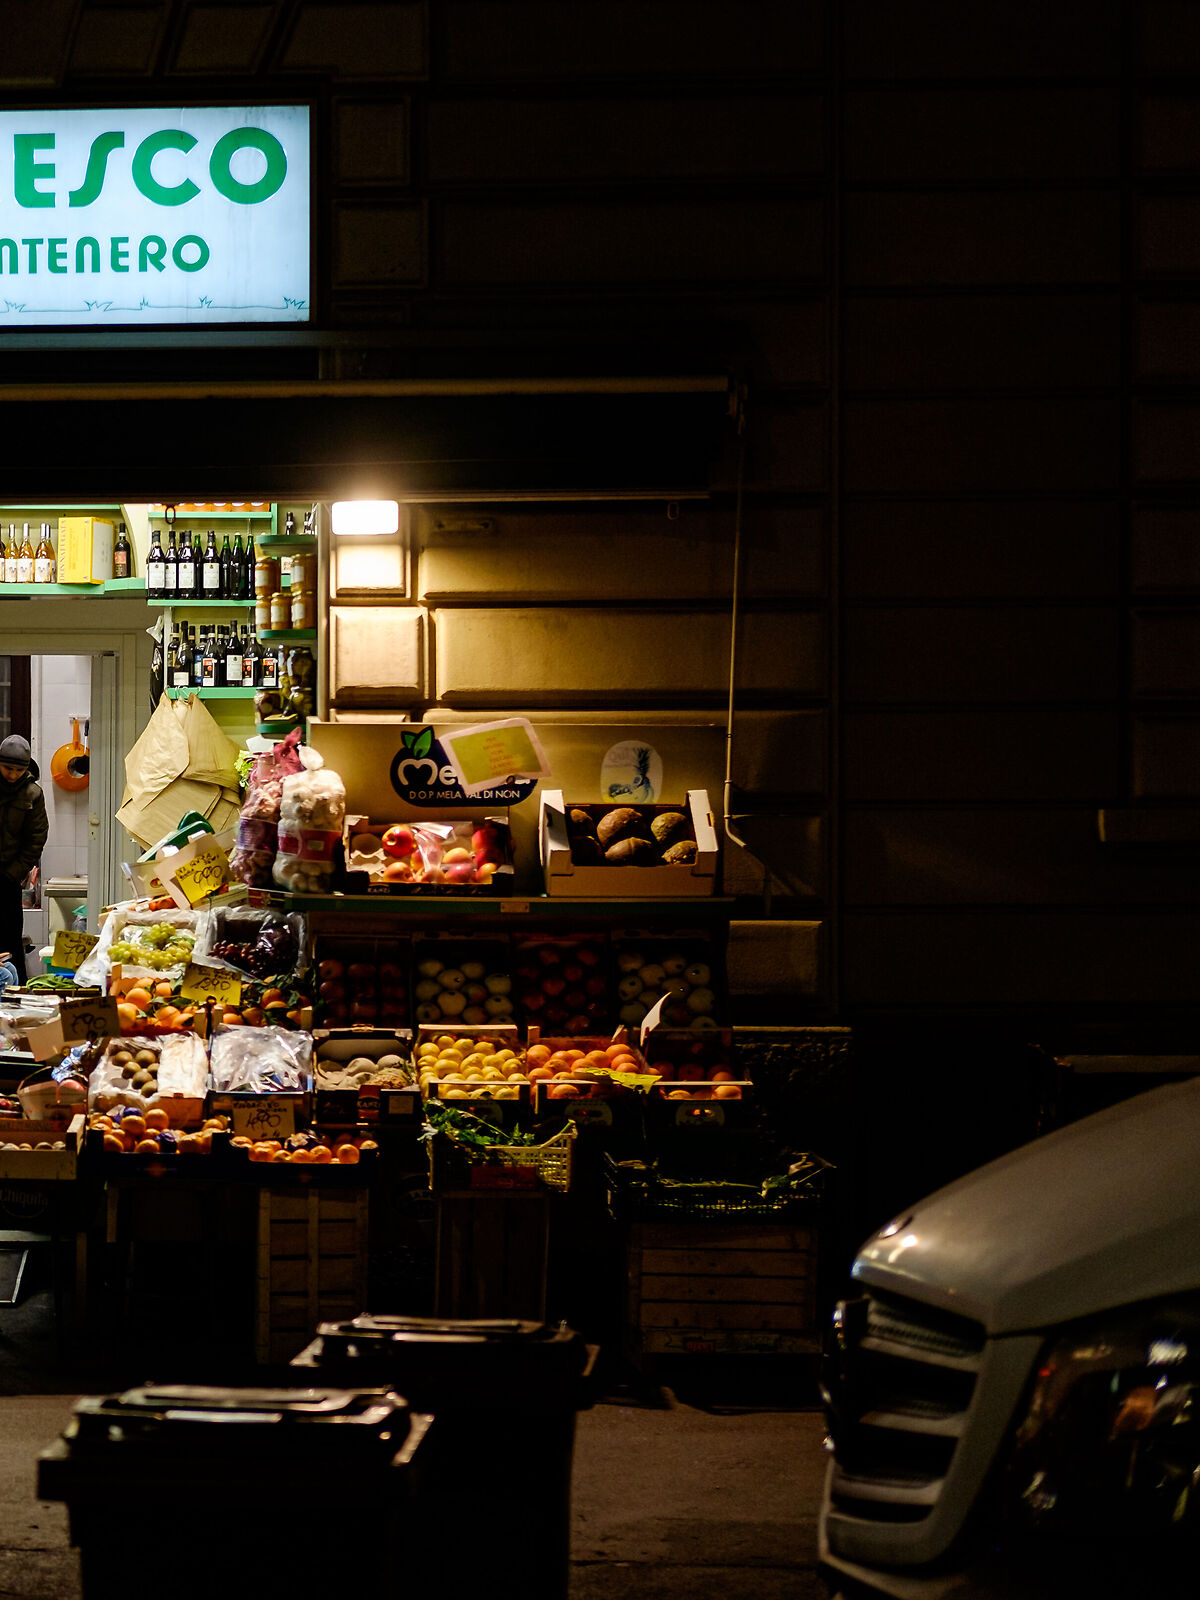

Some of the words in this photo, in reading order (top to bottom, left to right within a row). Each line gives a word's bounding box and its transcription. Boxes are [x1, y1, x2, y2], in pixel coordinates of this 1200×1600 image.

[436, 790, 462, 799] MELA
[484, 790, 493, 798] DI
[495, 790, 520, 798] NON
